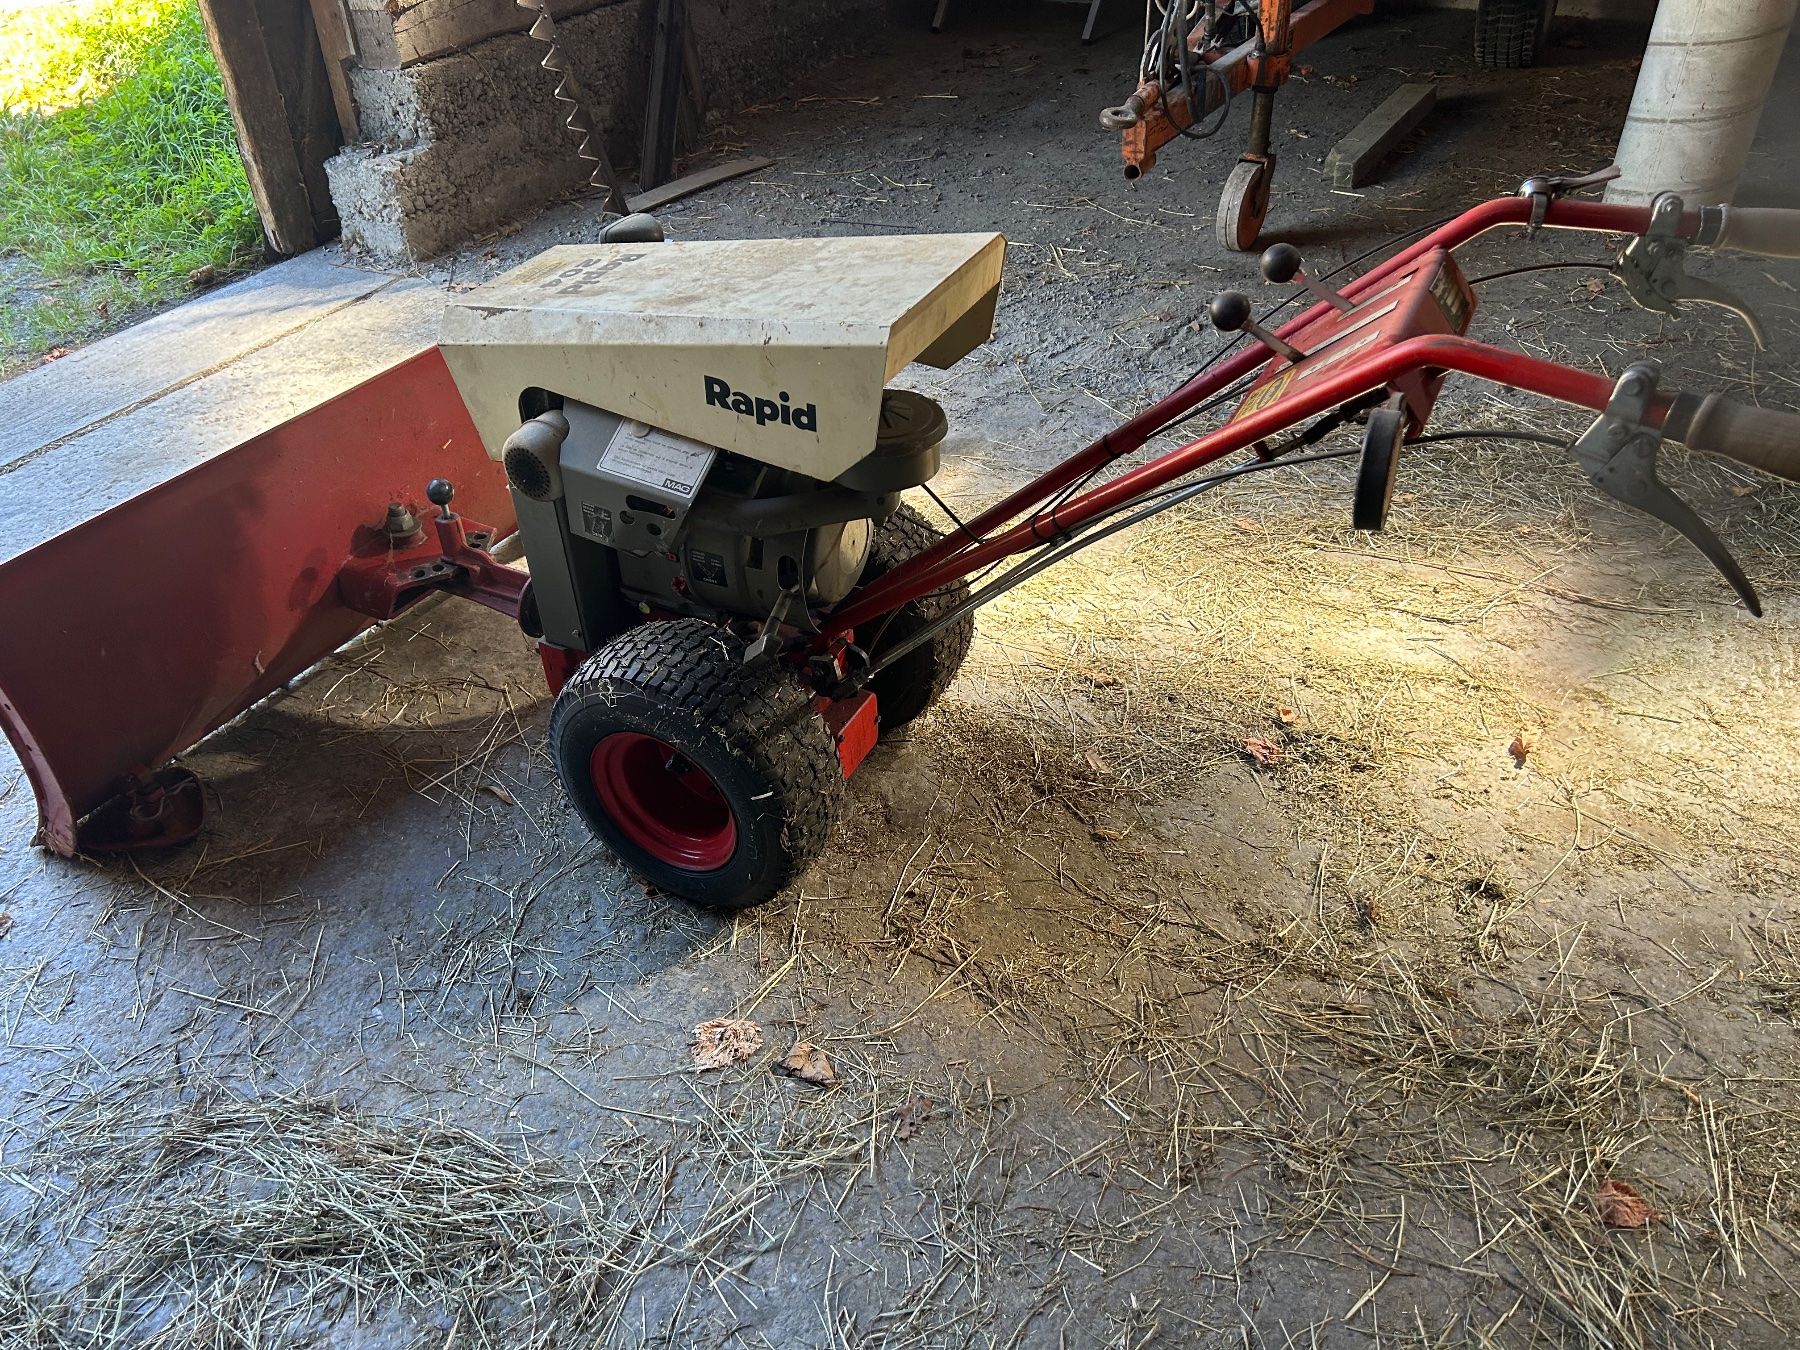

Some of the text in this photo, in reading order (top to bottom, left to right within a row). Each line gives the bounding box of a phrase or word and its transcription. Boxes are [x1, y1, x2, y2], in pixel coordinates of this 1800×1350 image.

[540, 258, 601, 288] 204
[555, 253, 647, 294] Rapid
[704, 374, 817, 433] Rapid
[664, 480, 691, 493] MAG
